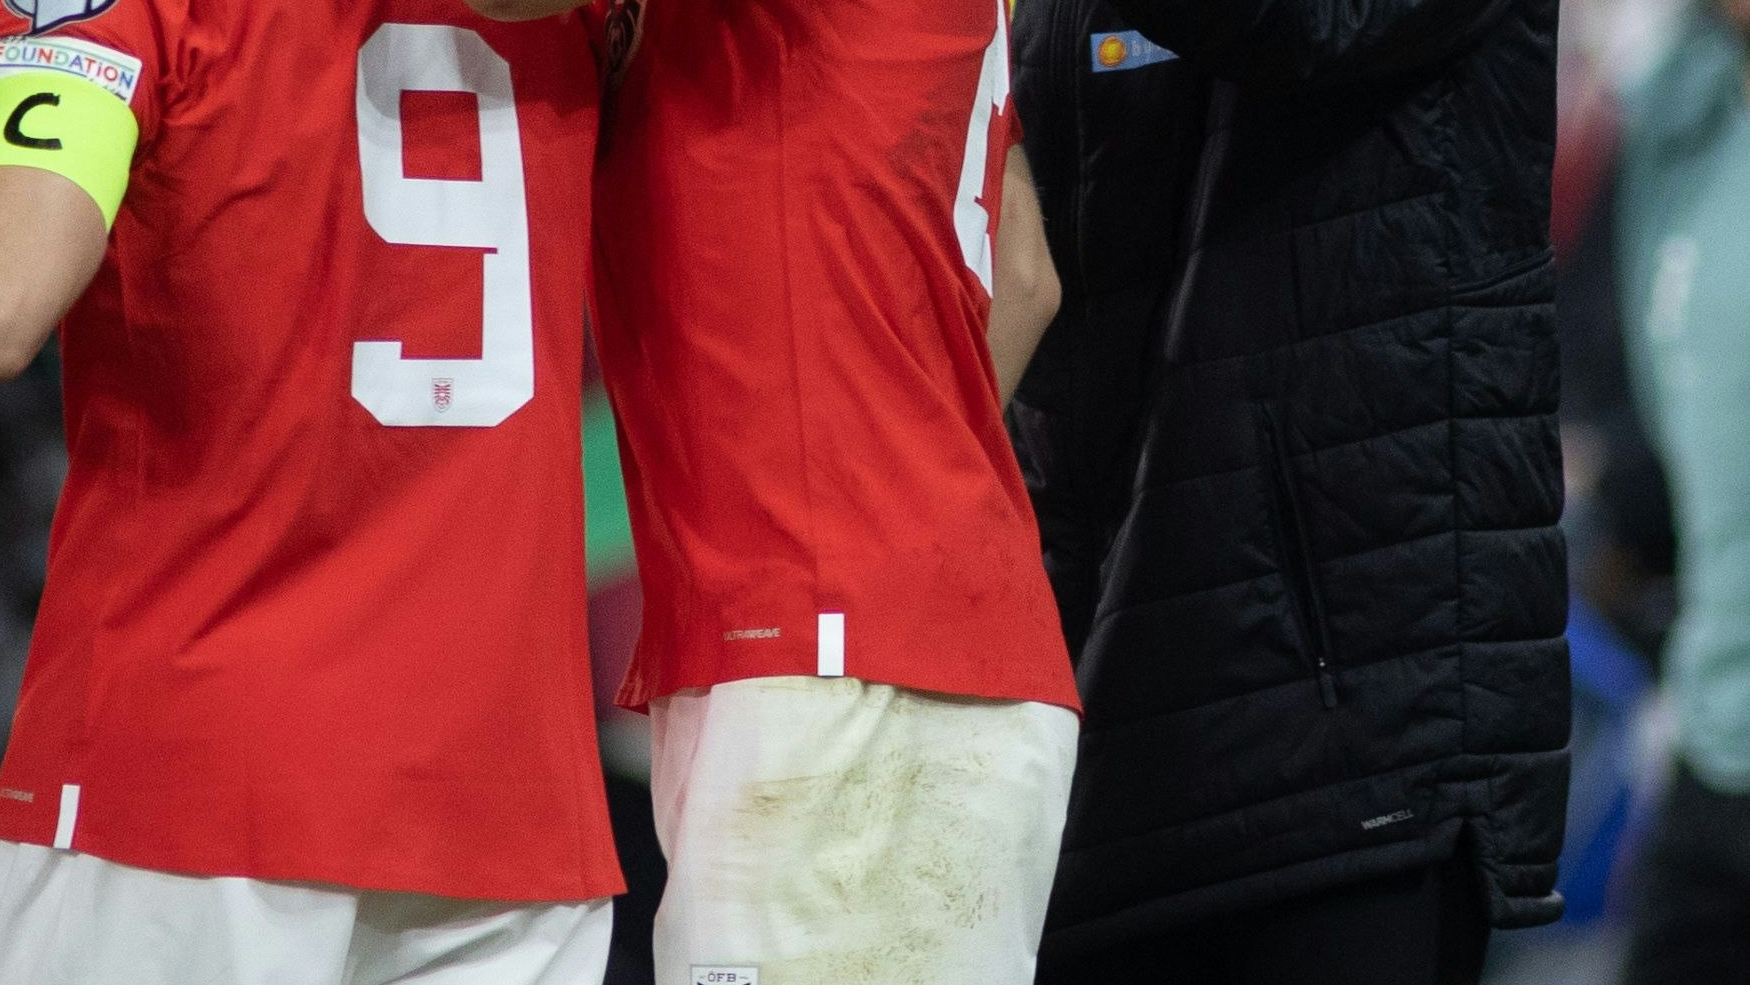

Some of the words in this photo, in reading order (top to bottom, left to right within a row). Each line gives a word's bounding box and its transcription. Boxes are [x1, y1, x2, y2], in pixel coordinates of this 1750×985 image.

[3, 92, 63, 151] C
[351, 22, 535, 427] 9
[707, 970, 737, 983] ÖFB
